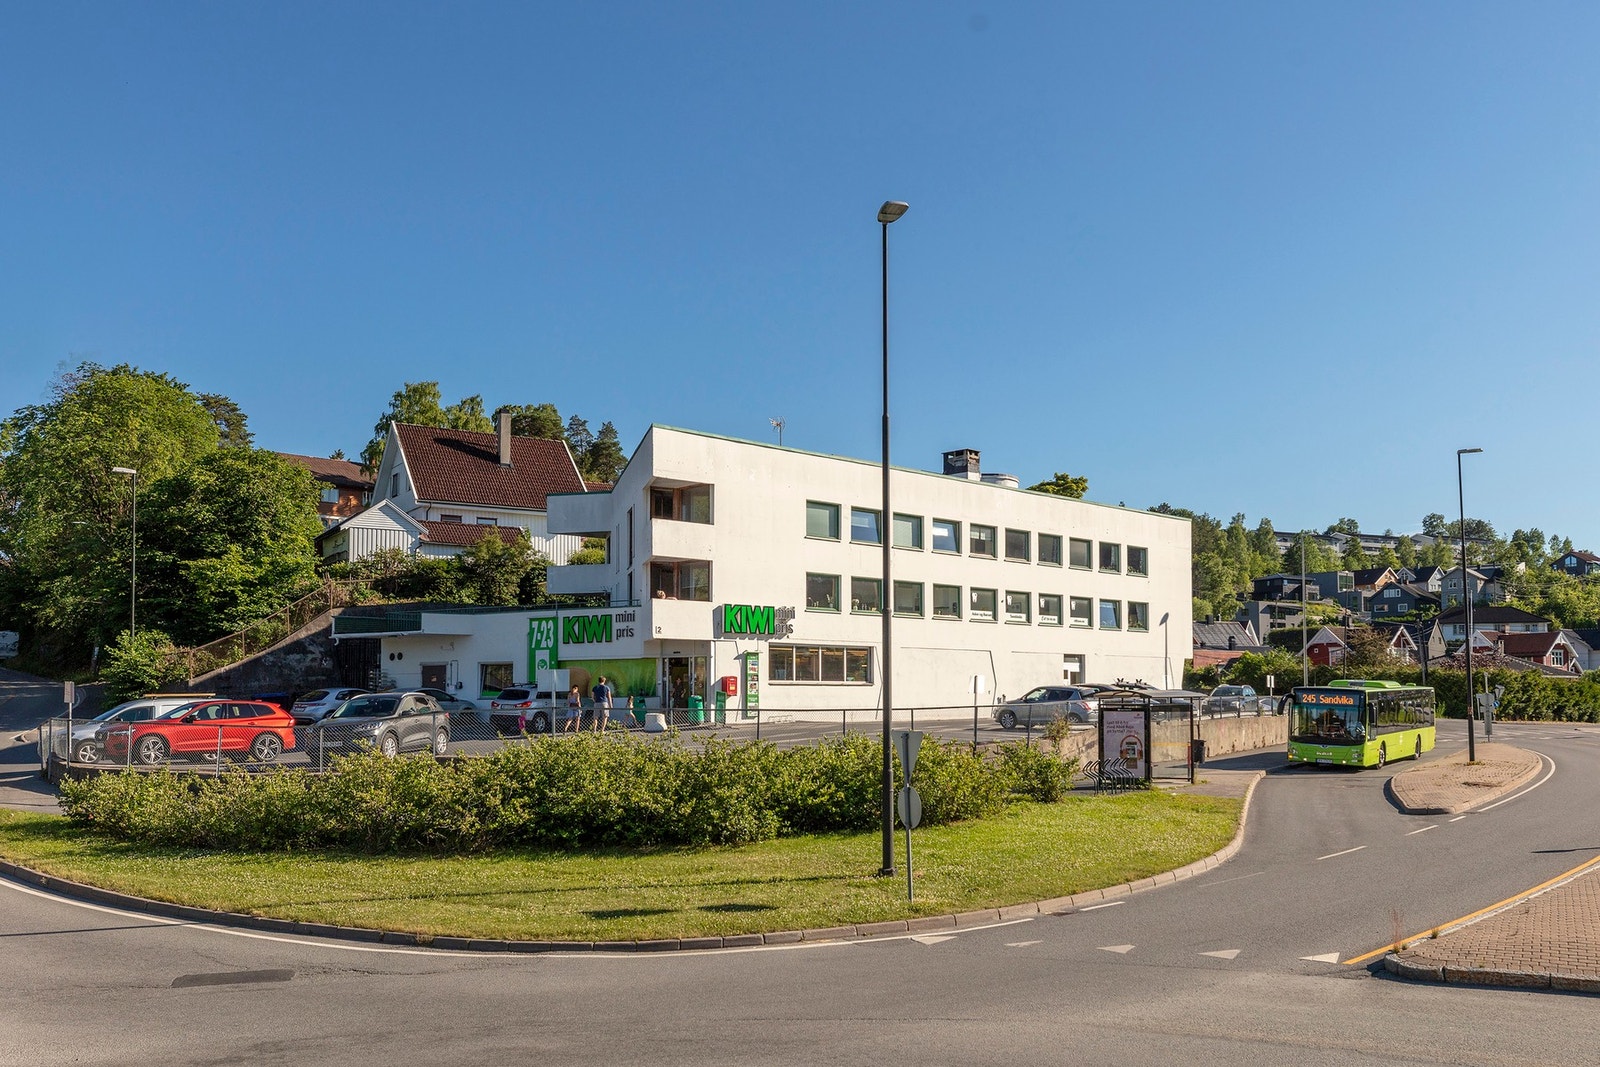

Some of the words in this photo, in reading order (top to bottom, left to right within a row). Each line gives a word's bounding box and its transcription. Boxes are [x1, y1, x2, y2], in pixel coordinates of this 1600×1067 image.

[615, 610, 636, 623] mini
[724, 604, 775, 634] KIWI
[776, 606, 795, 619] mini
[531, 620, 554, 648] 7-23
[562, 614, 613, 644] KIWI
[616, 625, 635, 640] pris
[775, 623, 794, 636] pris
[1302, 694, 1316, 703] 245
[1319, 695, 1354, 704] Sandvika
